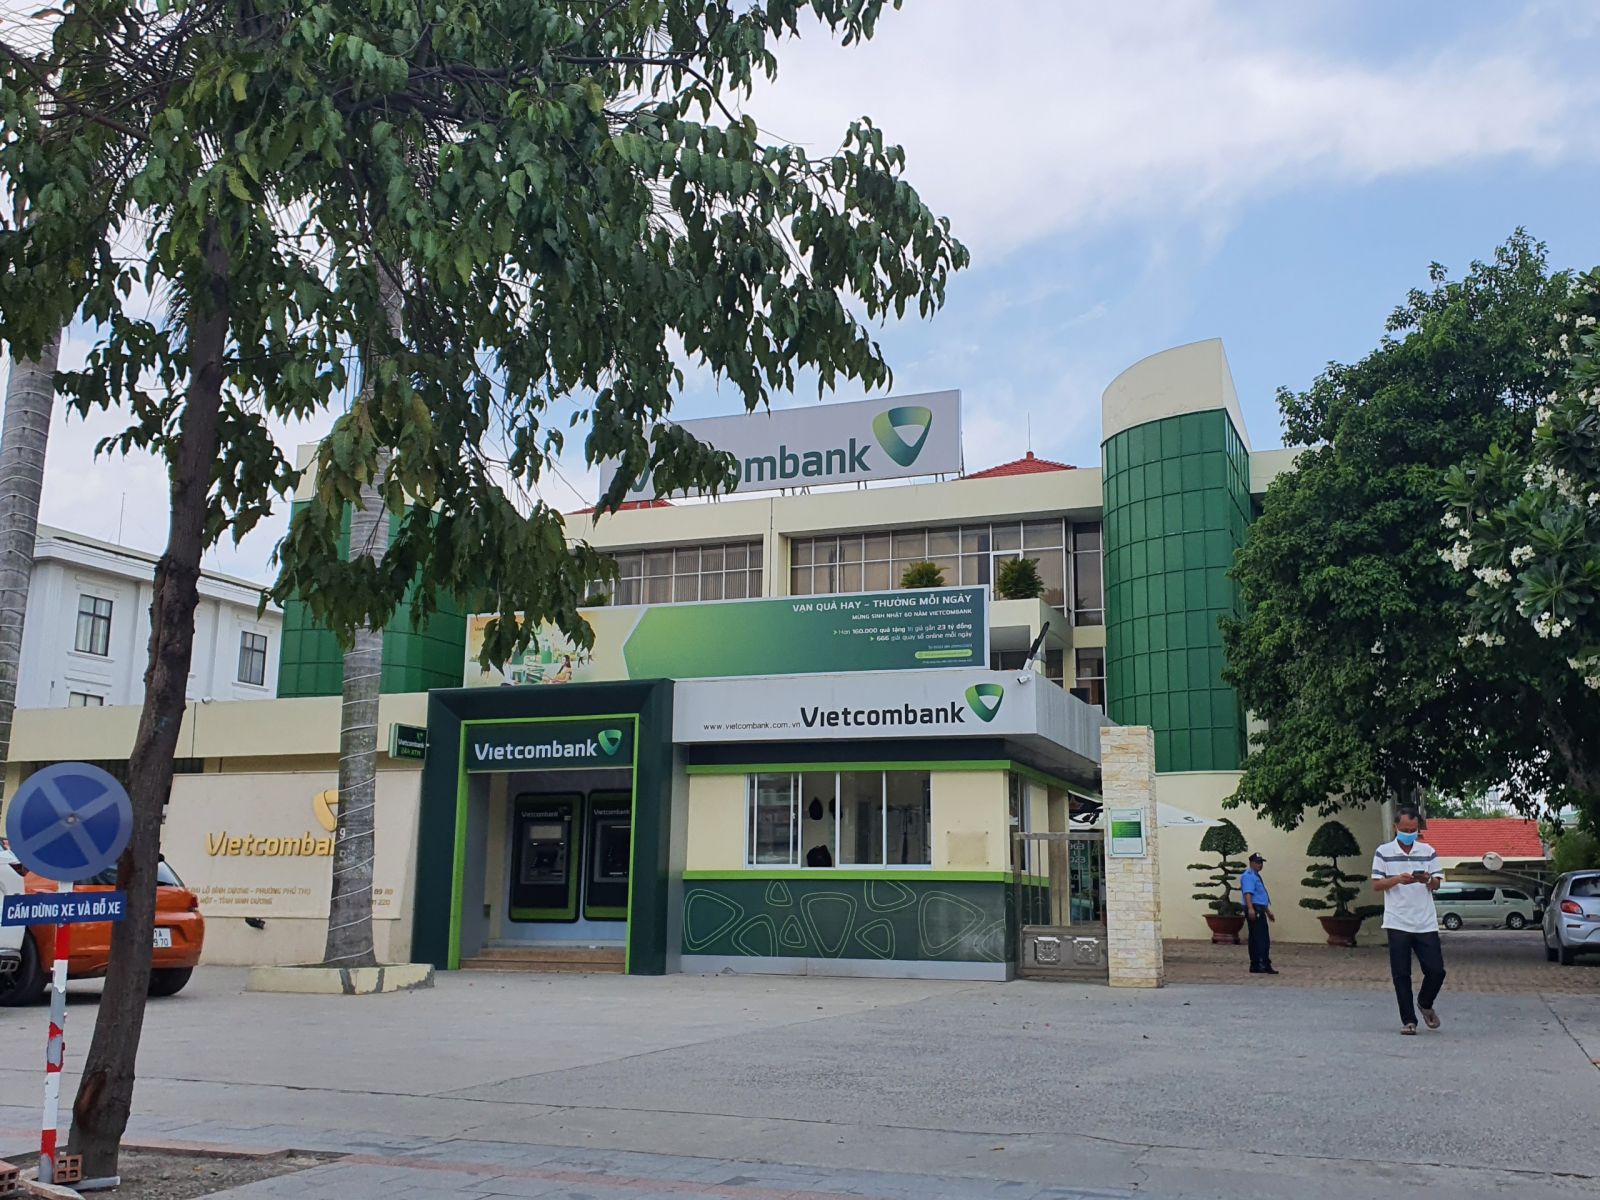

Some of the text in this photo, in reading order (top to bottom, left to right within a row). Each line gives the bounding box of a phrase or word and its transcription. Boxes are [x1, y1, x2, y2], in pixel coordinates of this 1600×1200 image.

[793, 604, 813, 613] VẠN
[817, 601, 837, 612] QUÀ
[841, 601, 861, 610] HAY
[919, 594, 939, 605] MỖI
[942, 594, 972, 604] NGÀY
[929, 608, 972, 616] VIETCOMBANK
[956, 622, 972, 630] đồng
[958, 631, 972, 639] ngày
[800, 701, 965, 728] Vietcombank
[703, 721, 800, 731] www.vietcombank.com.vn
[474, 739, 598, 761] Vietcombank
[205, 831, 335, 857] Vietcomba
[7, 898, 121, 919] CẤM DỪNG XE VÀ ĐỖ XE
